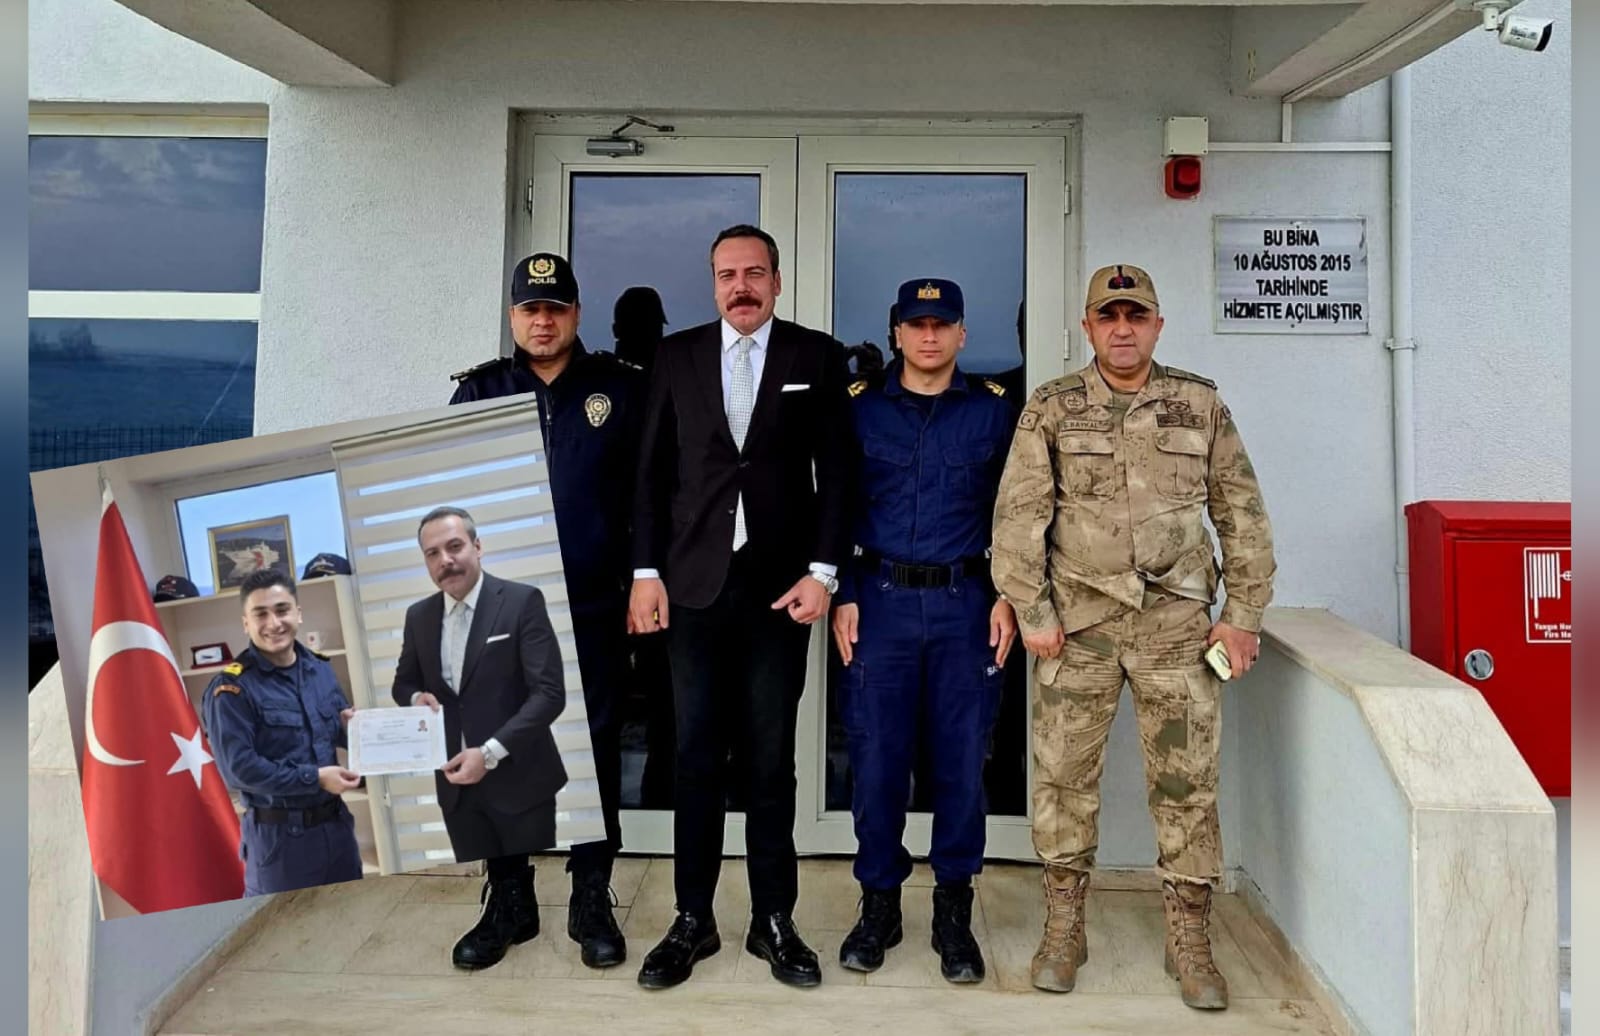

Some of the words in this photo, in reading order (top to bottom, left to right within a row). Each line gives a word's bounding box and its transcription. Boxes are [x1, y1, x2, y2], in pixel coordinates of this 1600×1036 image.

[1264, 230, 1283, 246] BU
[1286, 225, 1319, 246] BİNA
[1234, 254, 1248, 271] 10
[1251, 250, 1317, 271] AĞUSTOS
[1320, 254, 1351, 271] 2015
[1256, 275, 1328, 296] TARİHİNDE
[1223, 298, 1282, 319] HİZMETE
[1285, 303, 1362, 324] AÇILMIŞTIR
